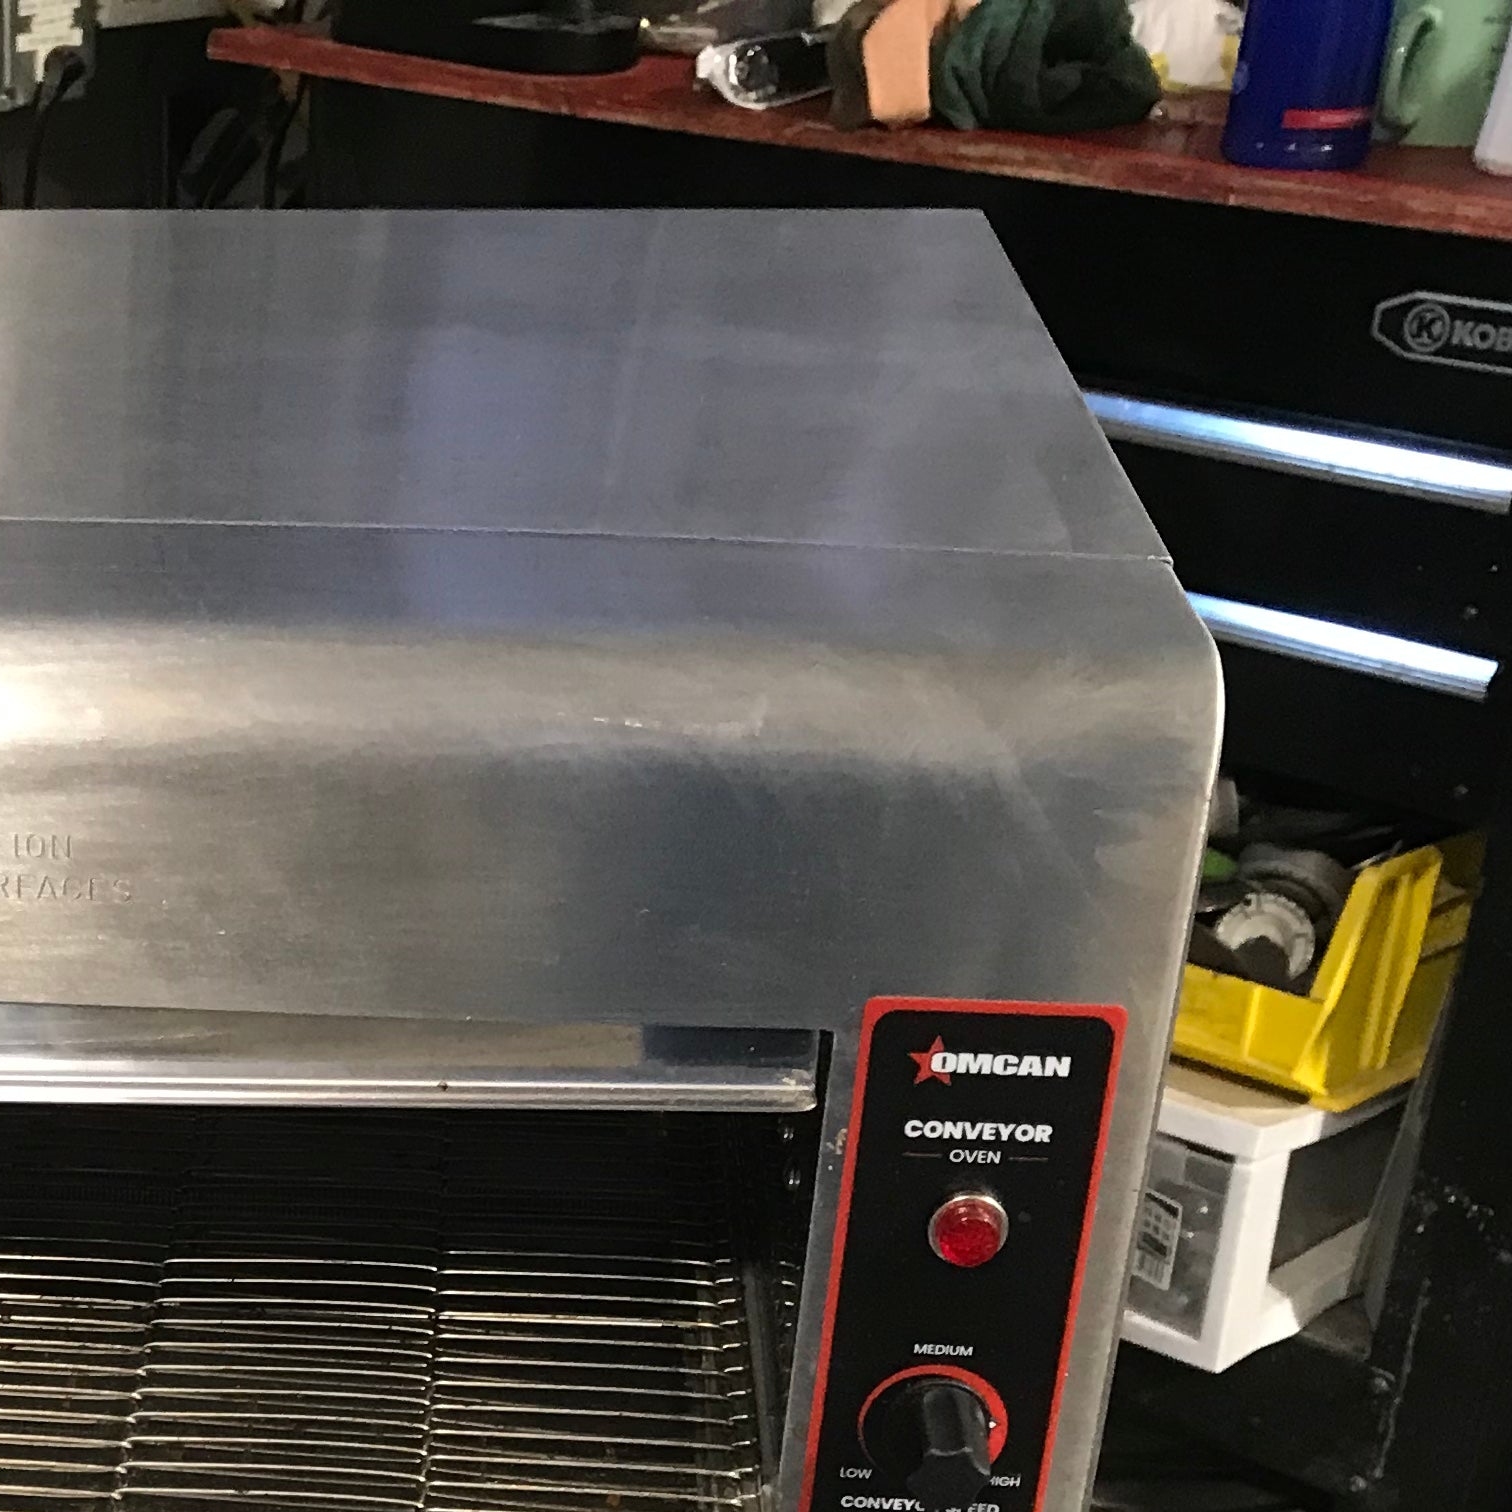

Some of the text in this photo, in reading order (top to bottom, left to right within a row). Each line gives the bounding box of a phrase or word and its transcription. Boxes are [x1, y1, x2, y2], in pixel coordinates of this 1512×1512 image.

[930, 1052, 1072, 1077] OMCAN
[904, 1120, 1053, 1143] CONVEYOR
[949, 1149, 1001, 1164] OVEN
[913, 1343, 973, 1356] MEDIUM
[840, 1467, 872, 1479] LOW
